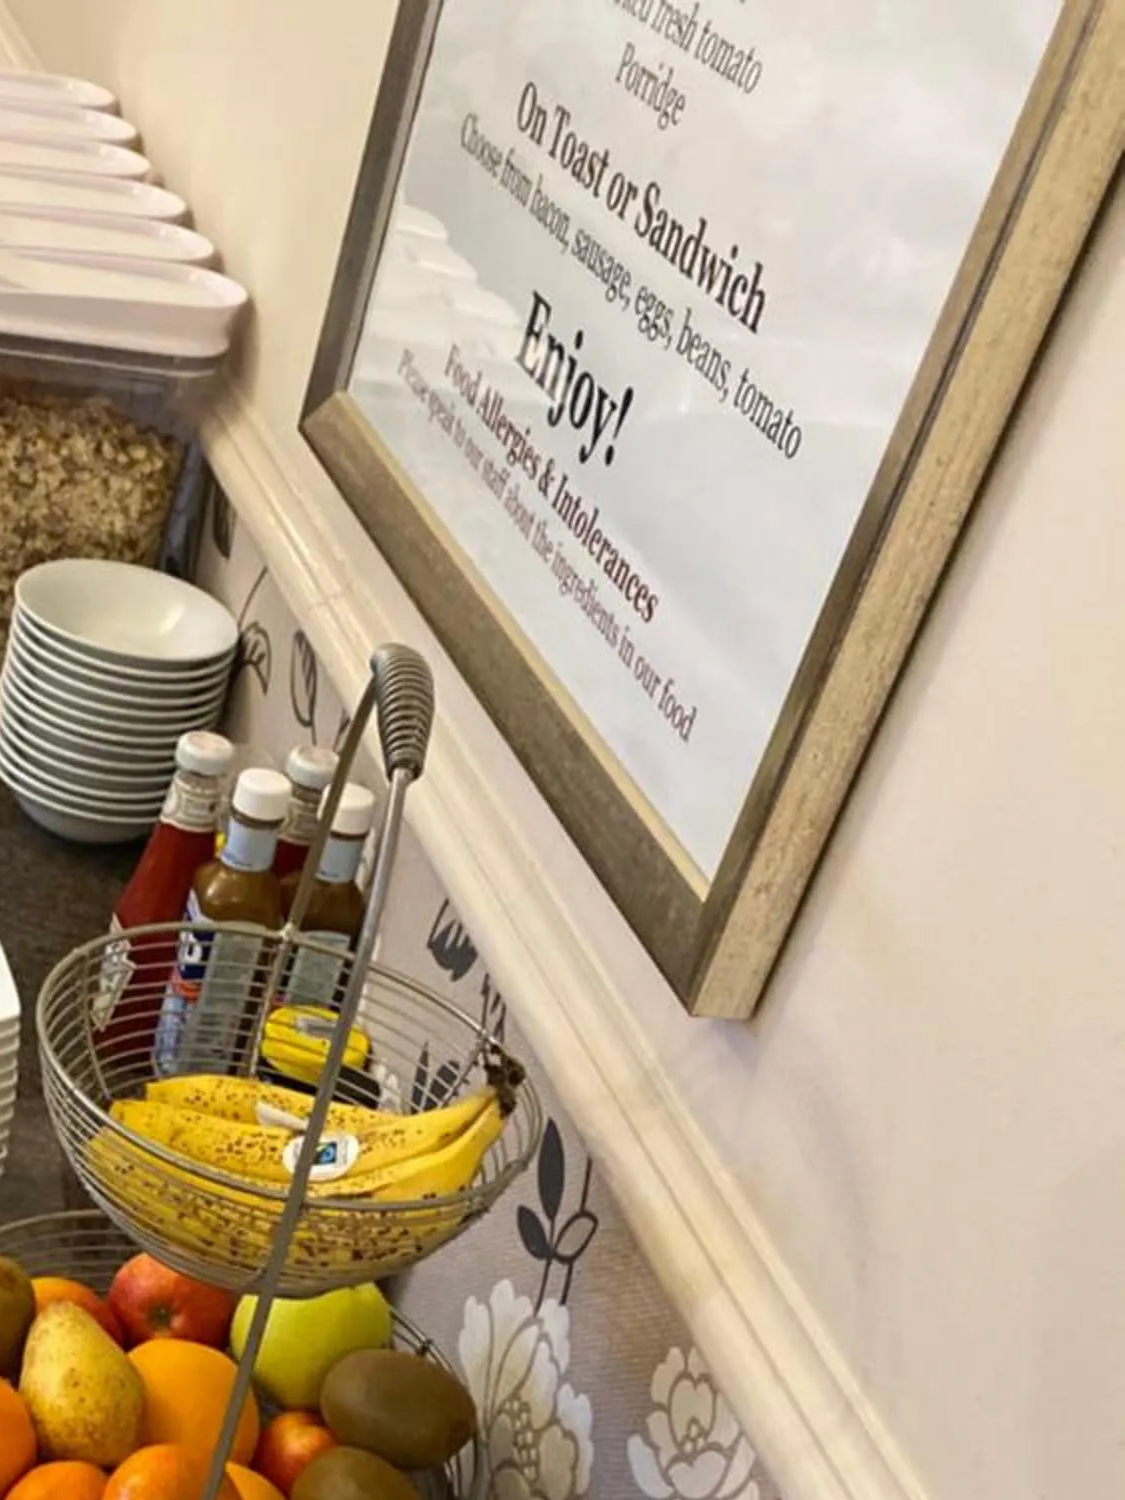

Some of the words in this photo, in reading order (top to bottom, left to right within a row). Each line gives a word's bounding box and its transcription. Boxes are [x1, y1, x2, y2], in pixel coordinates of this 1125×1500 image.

[615, 41, 686, 130] Porridge
[694, 19, 763, 95] tomato
[461, 112, 504, 178] Choose
[500, 147, 533, 207] from
[529, 173, 571, 255] bacon,
[570, 228, 632, 313] sausage,
[635, 285, 674, 351] eggs,
[676, 307, 732, 404] beans,
[733, 368, 803, 460] tomato
[517, 81, 548, 146] On
[548, 105, 610, 198] Toast
[607, 172, 638, 220] or
[634, 181, 766, 334] Sandwich
[515, 289, 635, 467] Enjoy!
[445, 343, 482, 407] Food
[476, 385, 541, 481] Allergies
[538, 458, 555, 498] &
[552, 473, 660, 624] Intolerances
[551, 541, 620, 648] ingredients
[618, 625, 636, 668] in
[634, 654, 661, 700] our
[657, 677, 698, 742] food
